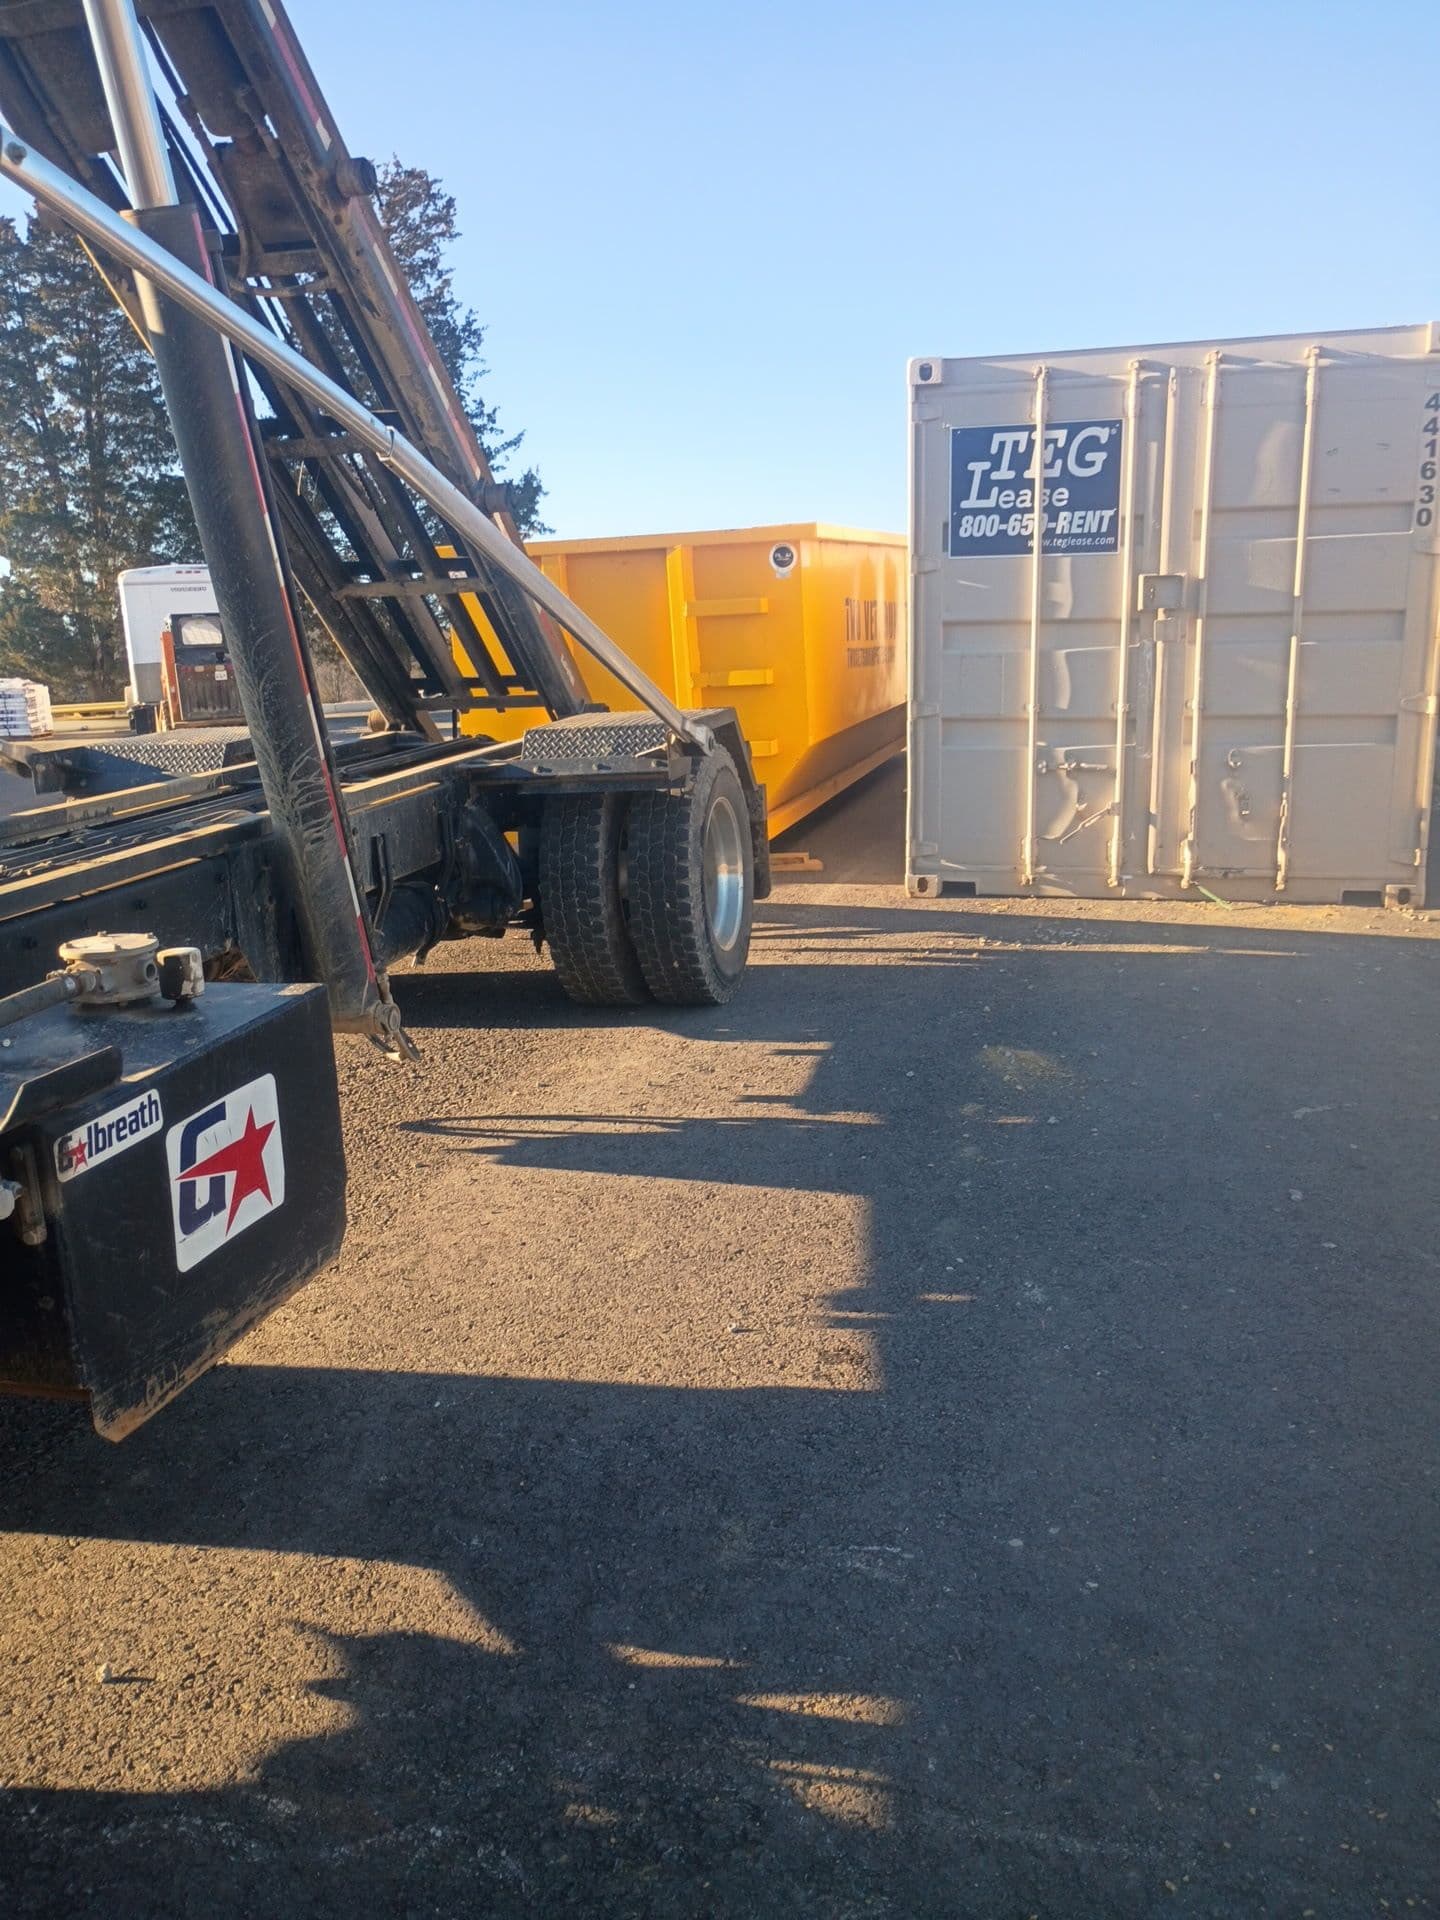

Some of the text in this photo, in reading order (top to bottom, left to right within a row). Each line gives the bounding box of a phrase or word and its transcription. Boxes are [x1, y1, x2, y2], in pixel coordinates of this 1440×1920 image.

[989, 426, 1112, 481] TEG
[1416, 393, 1440, 527] 441630
[959, 461, 1070, 509] Lease
[1027, 536, 1115, 549] ww.teglease.com
